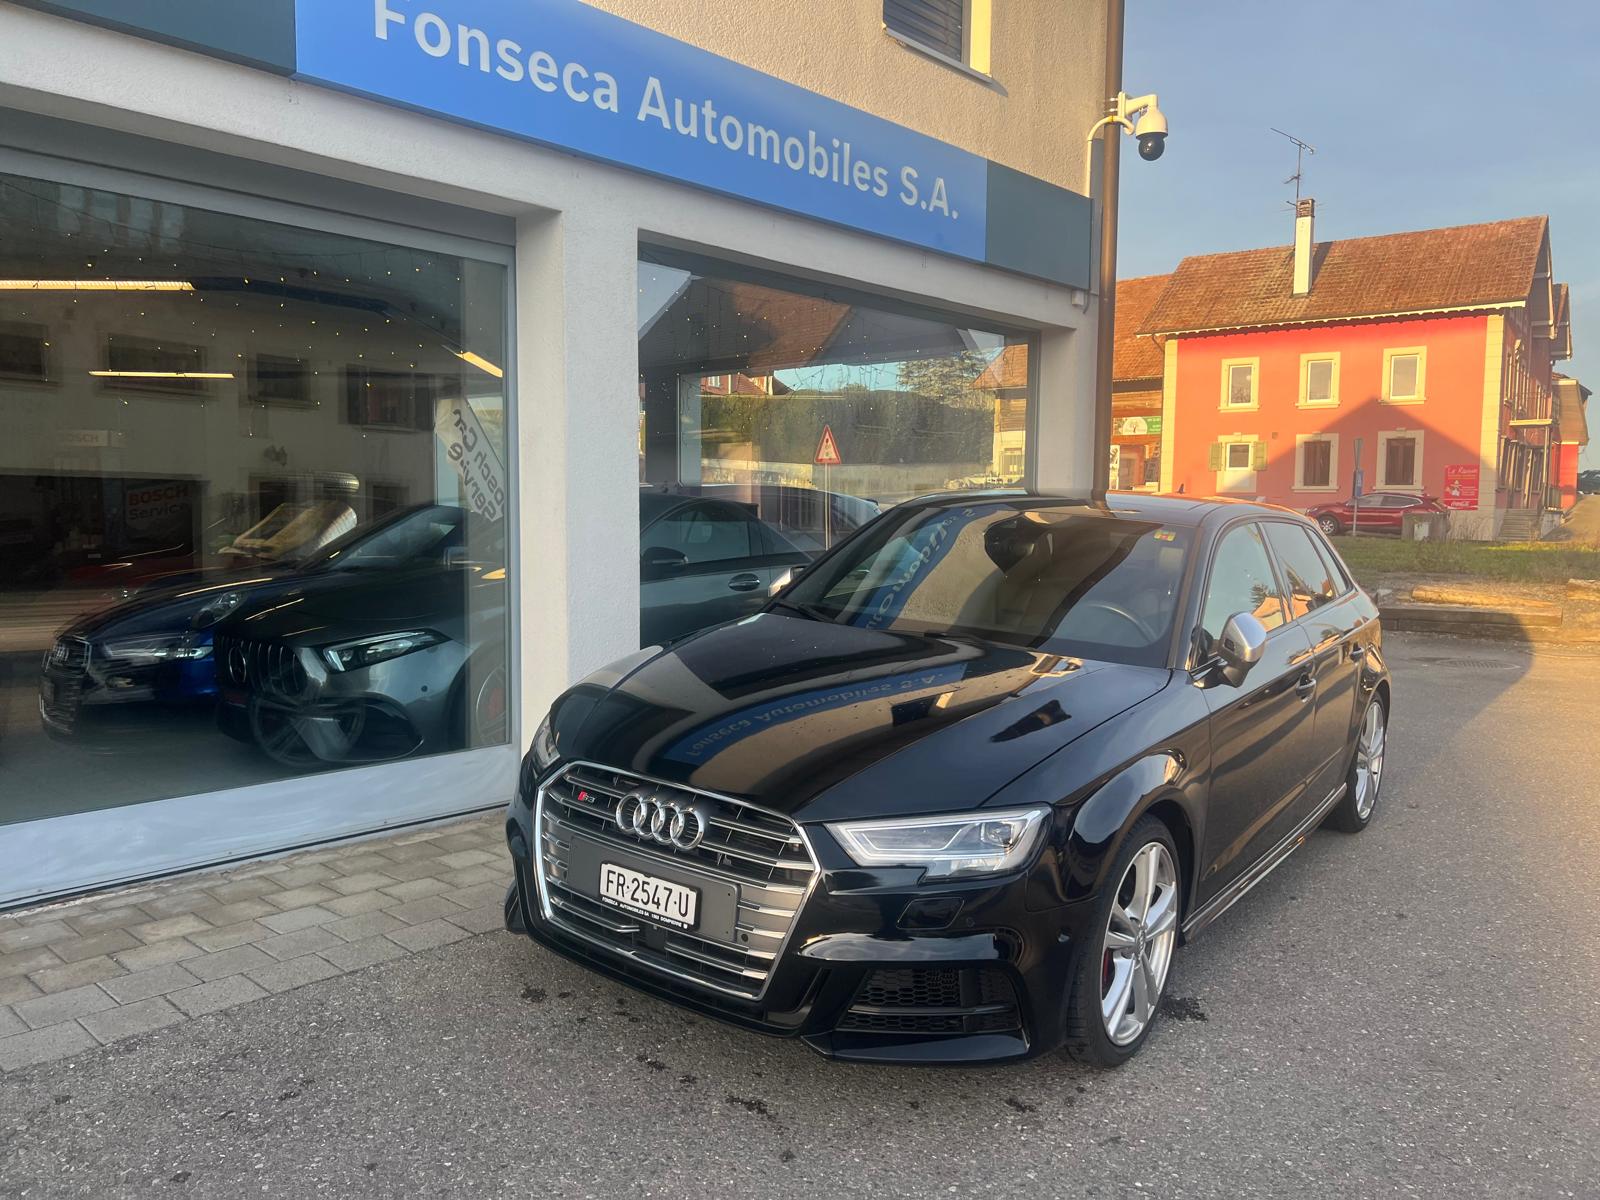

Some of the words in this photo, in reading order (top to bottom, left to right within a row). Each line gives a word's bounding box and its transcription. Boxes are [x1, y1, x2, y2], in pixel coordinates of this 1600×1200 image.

[375, 0, 618, 113] Fonseca
[637, 76, 888, 198] Automobiles
[899, 166, 958, 220] S.A.
